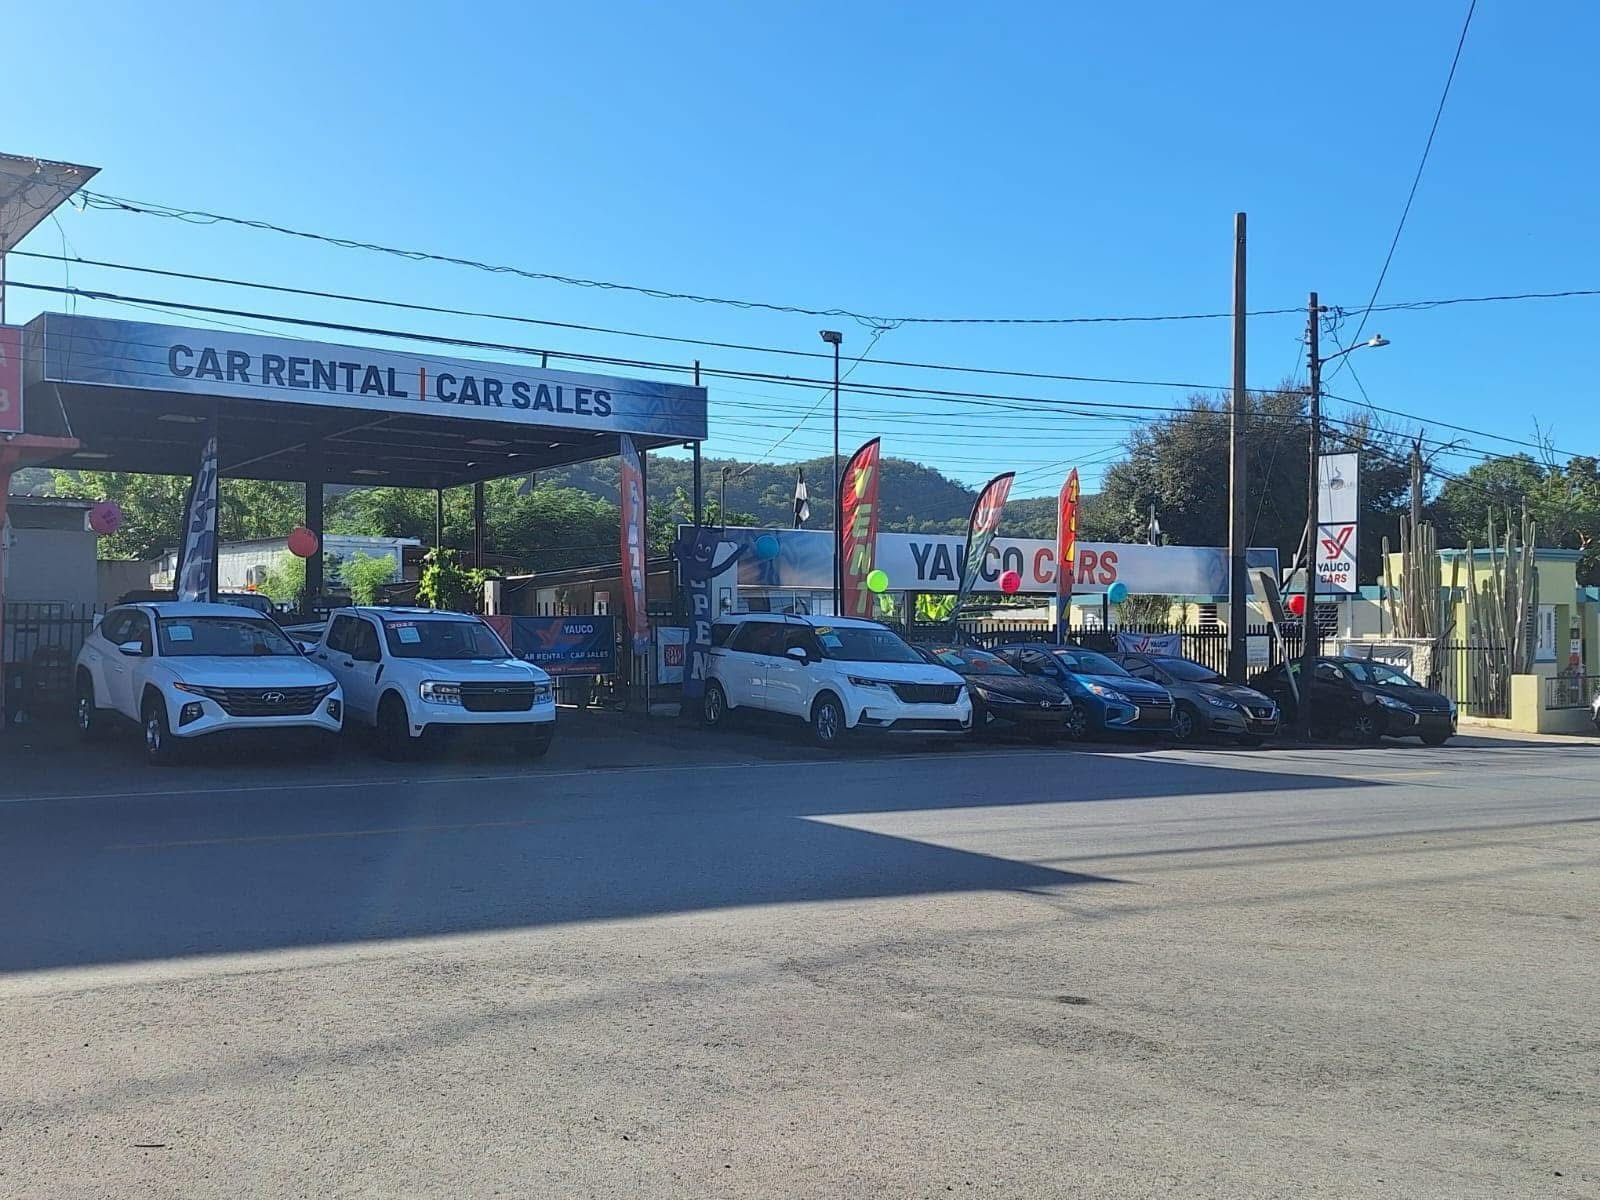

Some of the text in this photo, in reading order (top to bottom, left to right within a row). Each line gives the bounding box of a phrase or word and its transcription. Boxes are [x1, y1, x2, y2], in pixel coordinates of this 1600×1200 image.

[168, 344, 408, 398] CAR RENTAL
[436, 373, 612, 417] CAR SALES
[1033, 548, 1118, 585] CRS
[1317, 562, 1350, 572] YAUCO
[1321, 573, 1347, 583] CARS
[564, 624, 594, 634] YAUCO
